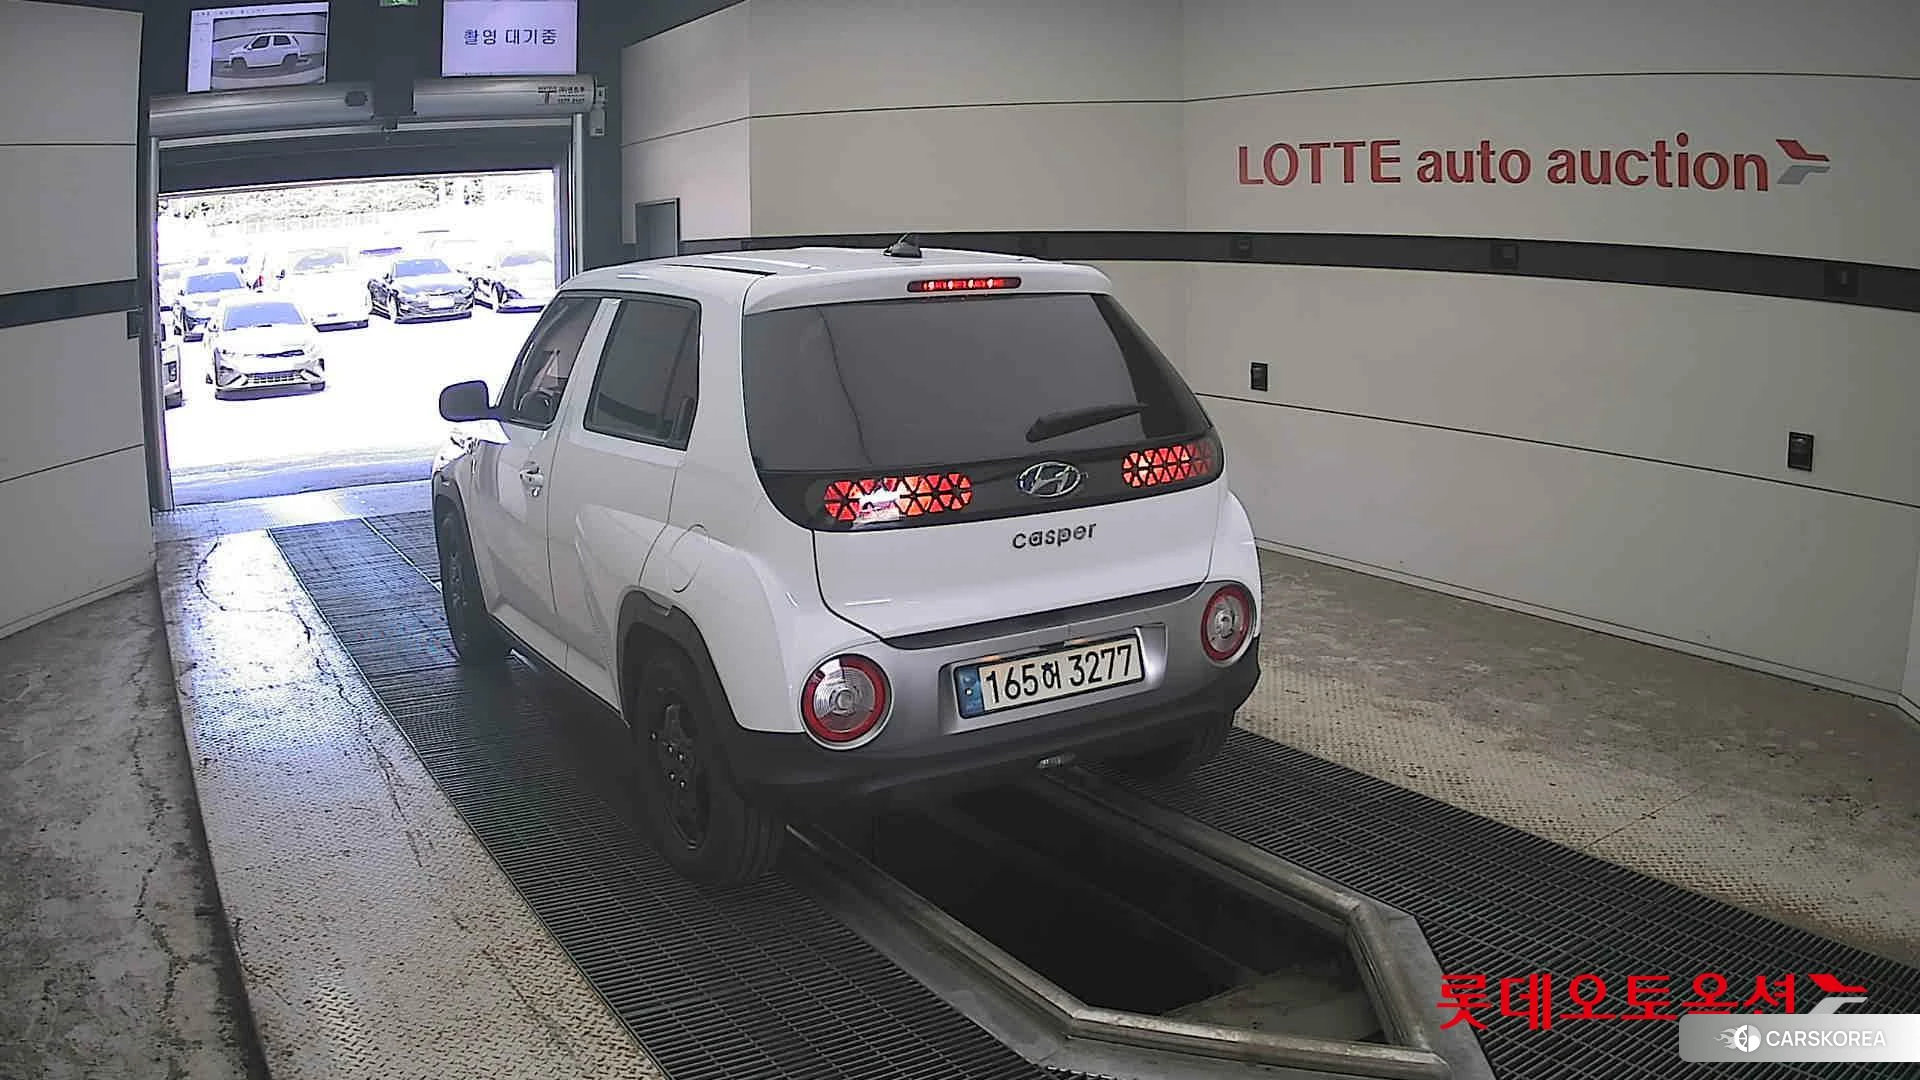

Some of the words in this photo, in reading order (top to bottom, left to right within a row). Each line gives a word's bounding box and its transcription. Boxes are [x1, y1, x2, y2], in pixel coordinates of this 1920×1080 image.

[464, 28, 497, 46] 촬영
[505, 28, 557, 46] 대기중
[1238, 139, 1401, 186] LOTTE
[1416, 140, 1532, 185] auto
[1546, 131, 1769, 192] auction
[1012, 522, 1097, 549] casper
[985, 660, 1062, 704] 165허
[1067, 644, 1132, 688] 3277
